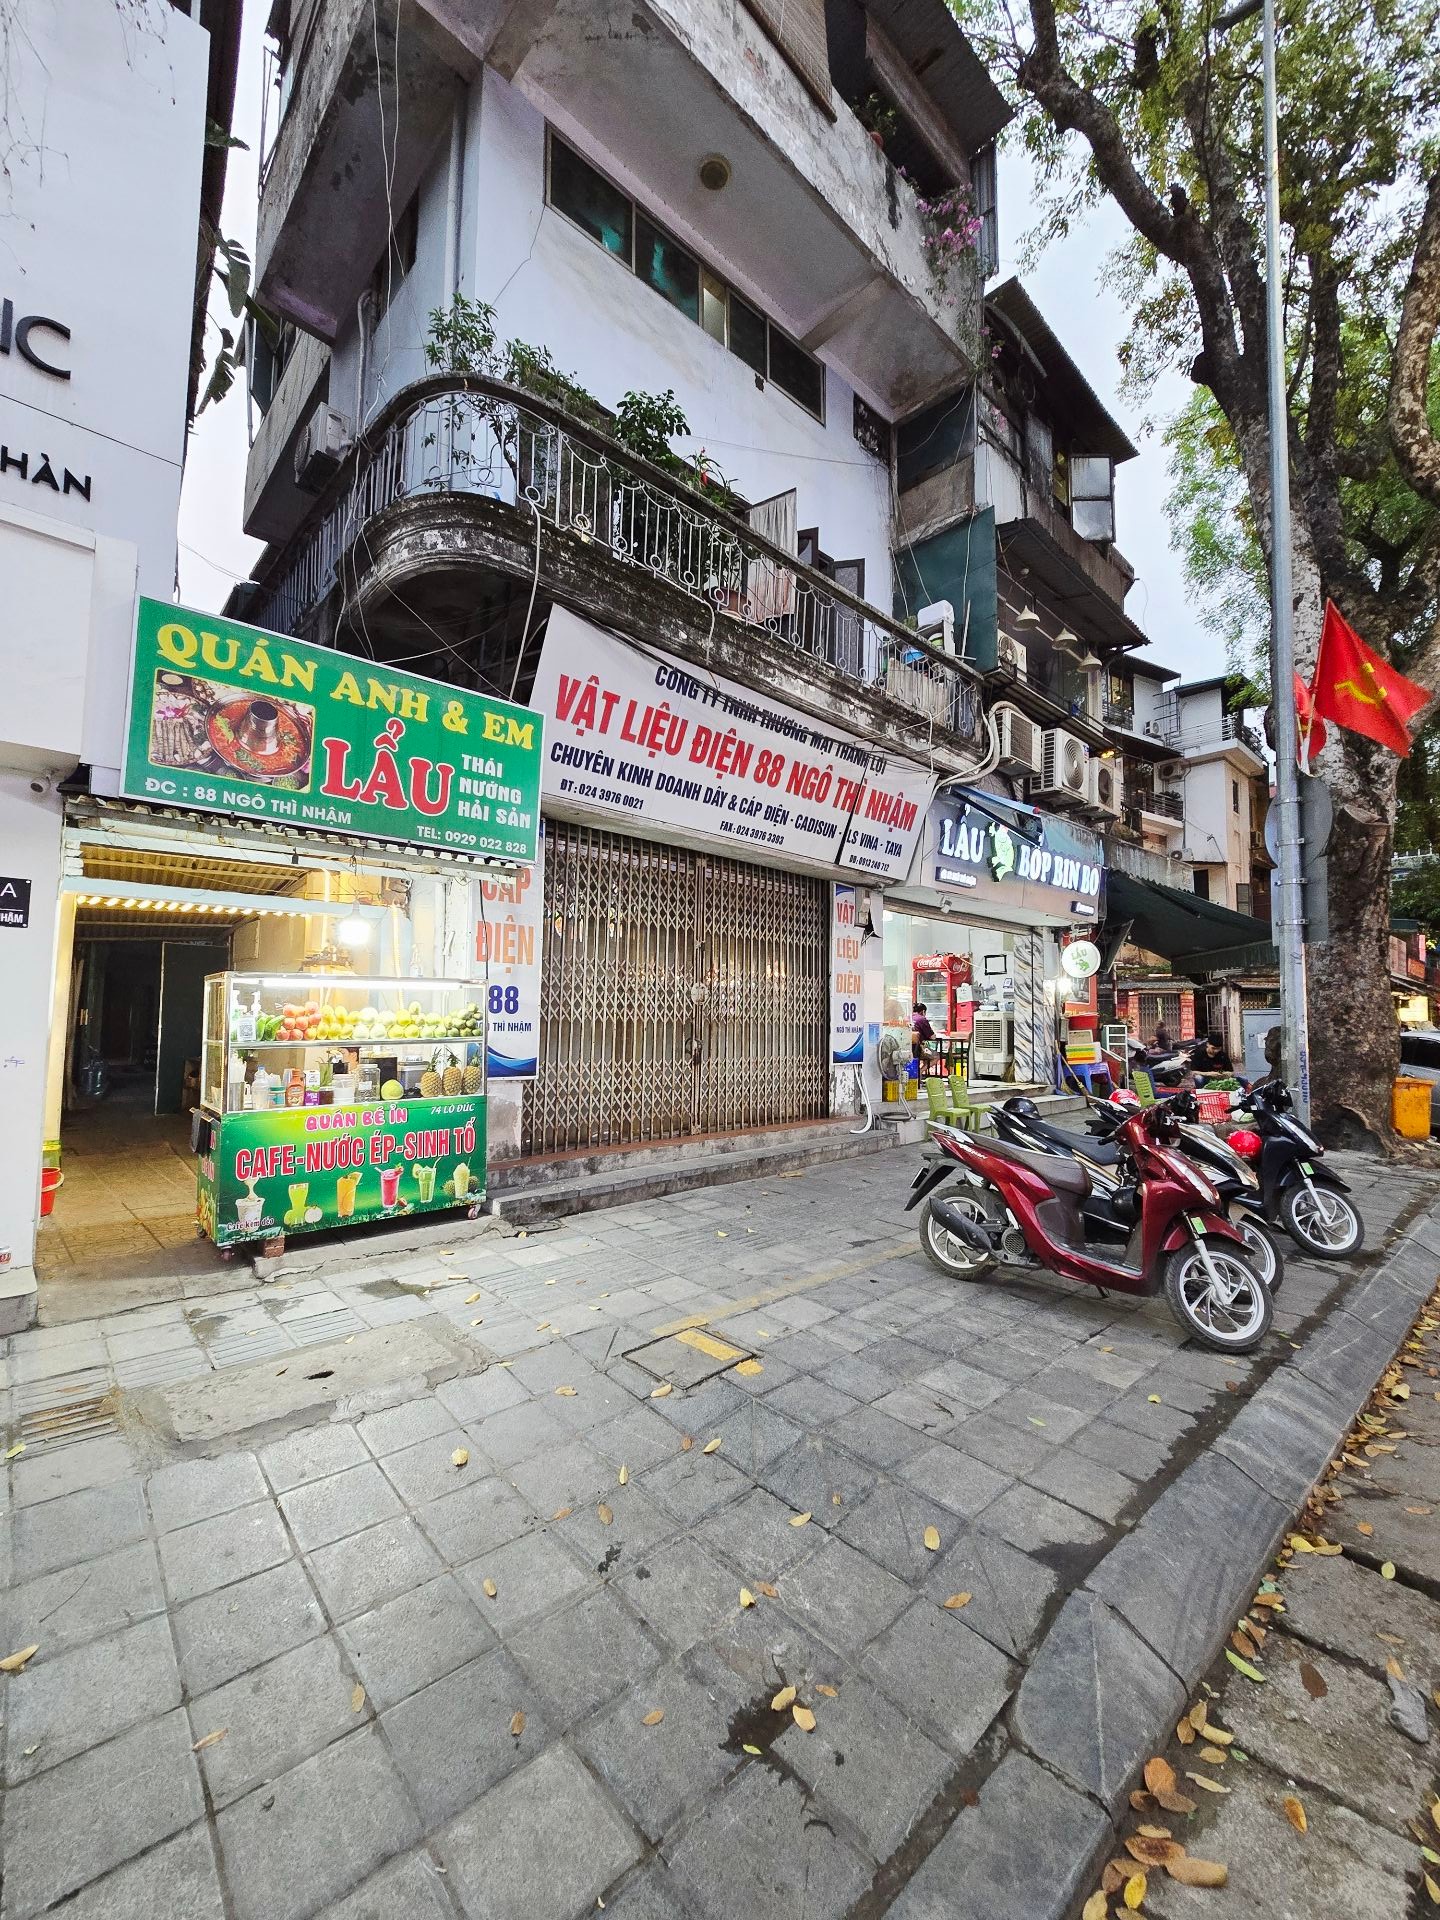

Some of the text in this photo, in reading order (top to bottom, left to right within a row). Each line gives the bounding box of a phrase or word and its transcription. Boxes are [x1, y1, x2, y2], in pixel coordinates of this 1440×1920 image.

[0, 445, 91, 502] HÀN
[156, 623, 534, 750] QUÁN ANH & EM
[319, 717, 455, 816] LẨU
[461, 753, 503, 778] THÁI
[555, 673, 919, 833] VẬT LIỆU ĐIỆN 88 NGÔ THÌ NHẬM
[145, 777, 177, 795] ĐC
[193, 785, 217, 801] 88
[222, 790, 266, 810] NGÔ
[270, 797, 297, 816] THÌ
[301, 804, 352, 826] NHẬM
[459, 776, 523, 805] NƯỚNG
[550, 742, 615, 778] CHUYÊN
[616, 760, 653, 788] KINH
[655, 772, 703, 802] DOANH
[703, 785, 729, 808] DÂY
[728, 796, 737, 812] &
[738, 794, 762, 817] CÁP
[763, 803, 790, 827] ĐIỆN
[795, 813, 838, 839] CADISUN
[846, 828, 860, 845] LS
[859, 832, 879, 851] VINA
[884, 840, 903, 858] TAYA
[578, 783, 597, 799] 024
[598, 788, 622, 804] 3976
[622, 795, 644, 810] 0021
[457, 799, 531, 829] HẢI SẢN
[416, 825, 527, 855] TEL: 0929 022 828
[736, 824, 750, 837] 024
[750, 828, 767, 841] 3976
[1052, 855, 1081, 891] BIN
[836, 899, 855, 928] VẬT
[475, 914, 535, 974] ĐIỆN
[836, 935, 859, 963] LIỆU
[487, 984, 519, 1014] 88
[835, 970, 862, 998] ĐIỆN
[842, 1002, 857, 1021] 88
[492, 1020, 506, 1032] THÌ
[507, 1020, 532, 1034] NHẬM
[305, 1109, 357, 1131] QUÁN
[362, 1107, 385, 1125] BÉ
[430, 1105, 442, 1115] 74
[454, 1116, 477, 1156] TỐ
